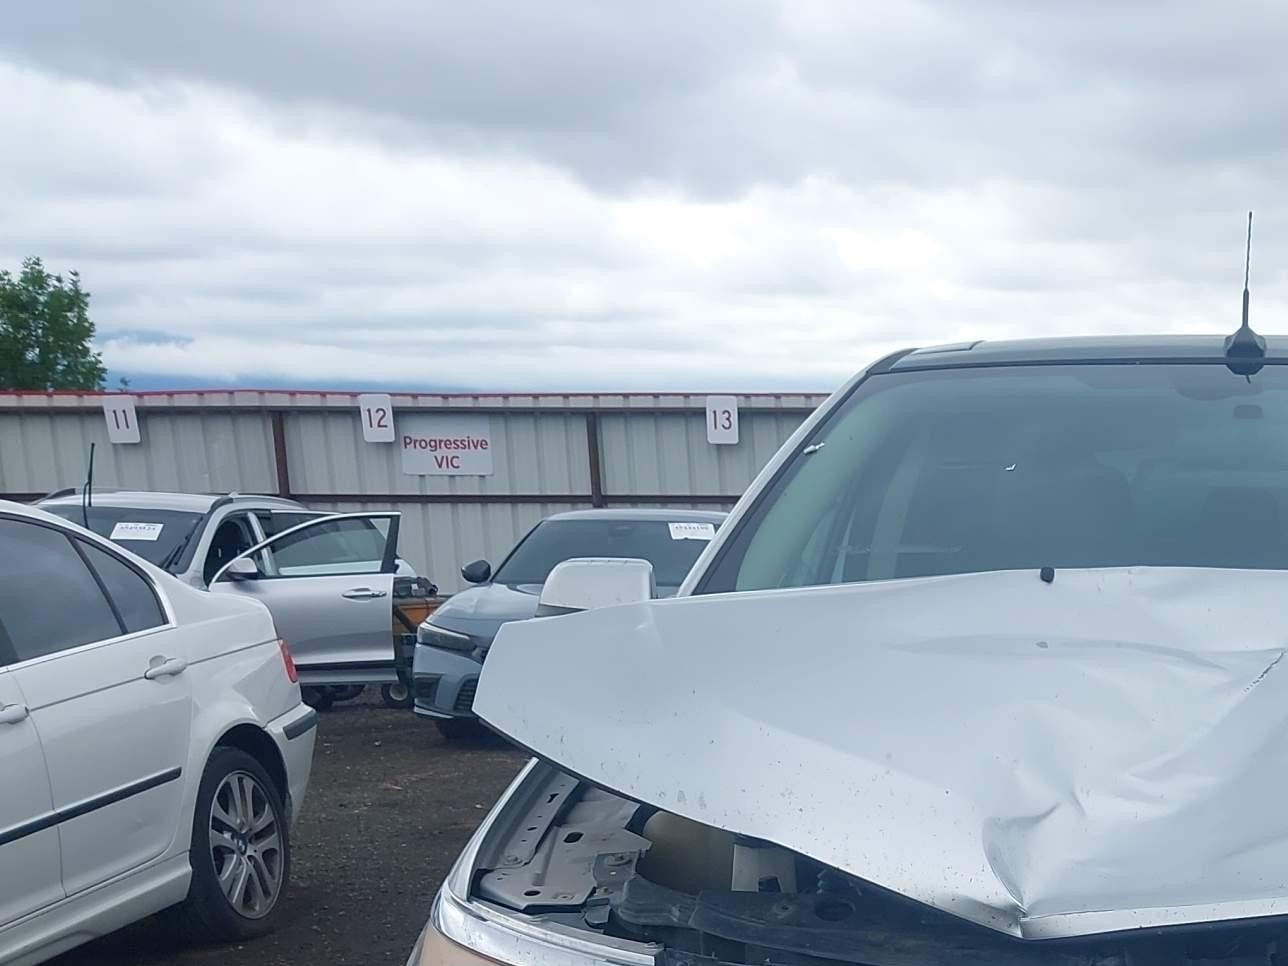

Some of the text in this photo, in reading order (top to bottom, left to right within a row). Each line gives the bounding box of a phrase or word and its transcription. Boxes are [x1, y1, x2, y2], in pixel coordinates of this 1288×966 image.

[112, 408, 130, 430] 11
[366, 407, 388, 429] 12
[712, 409, 732, 431] 13
[403, 435, 489, 452] Progressive
[434, 455, 461, 469] VIC
